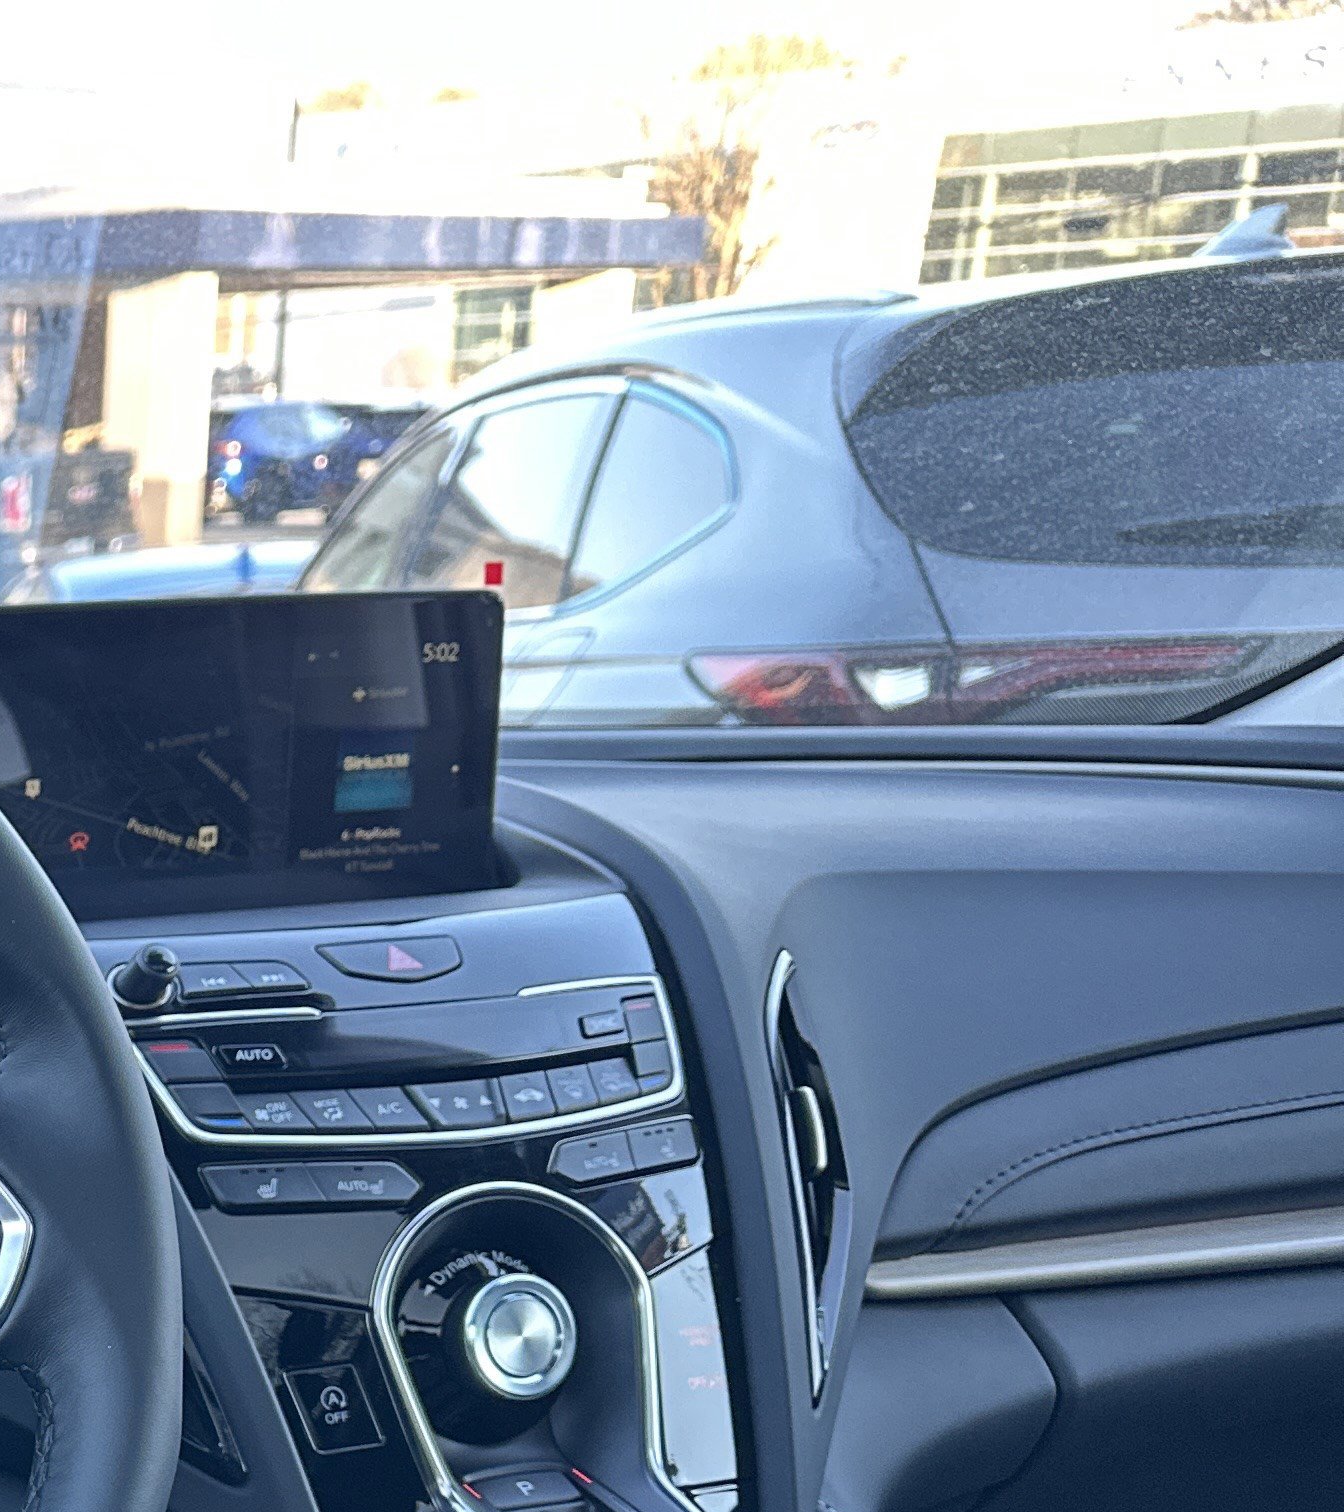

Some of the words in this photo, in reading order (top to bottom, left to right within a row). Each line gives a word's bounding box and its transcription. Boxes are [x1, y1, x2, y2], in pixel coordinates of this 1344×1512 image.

[422, 641, 460, 664] 5:02
[343, 753, 410, 772] SiriusXM
[235, 1048, 274, 1062] AUTO
[377, 1102, 405, 1116] A/C
[337, 1179, 368, 1192] AUTO
[324, 1410, 350, 1426] OFF
[516, 1480, 535, 1496] P
